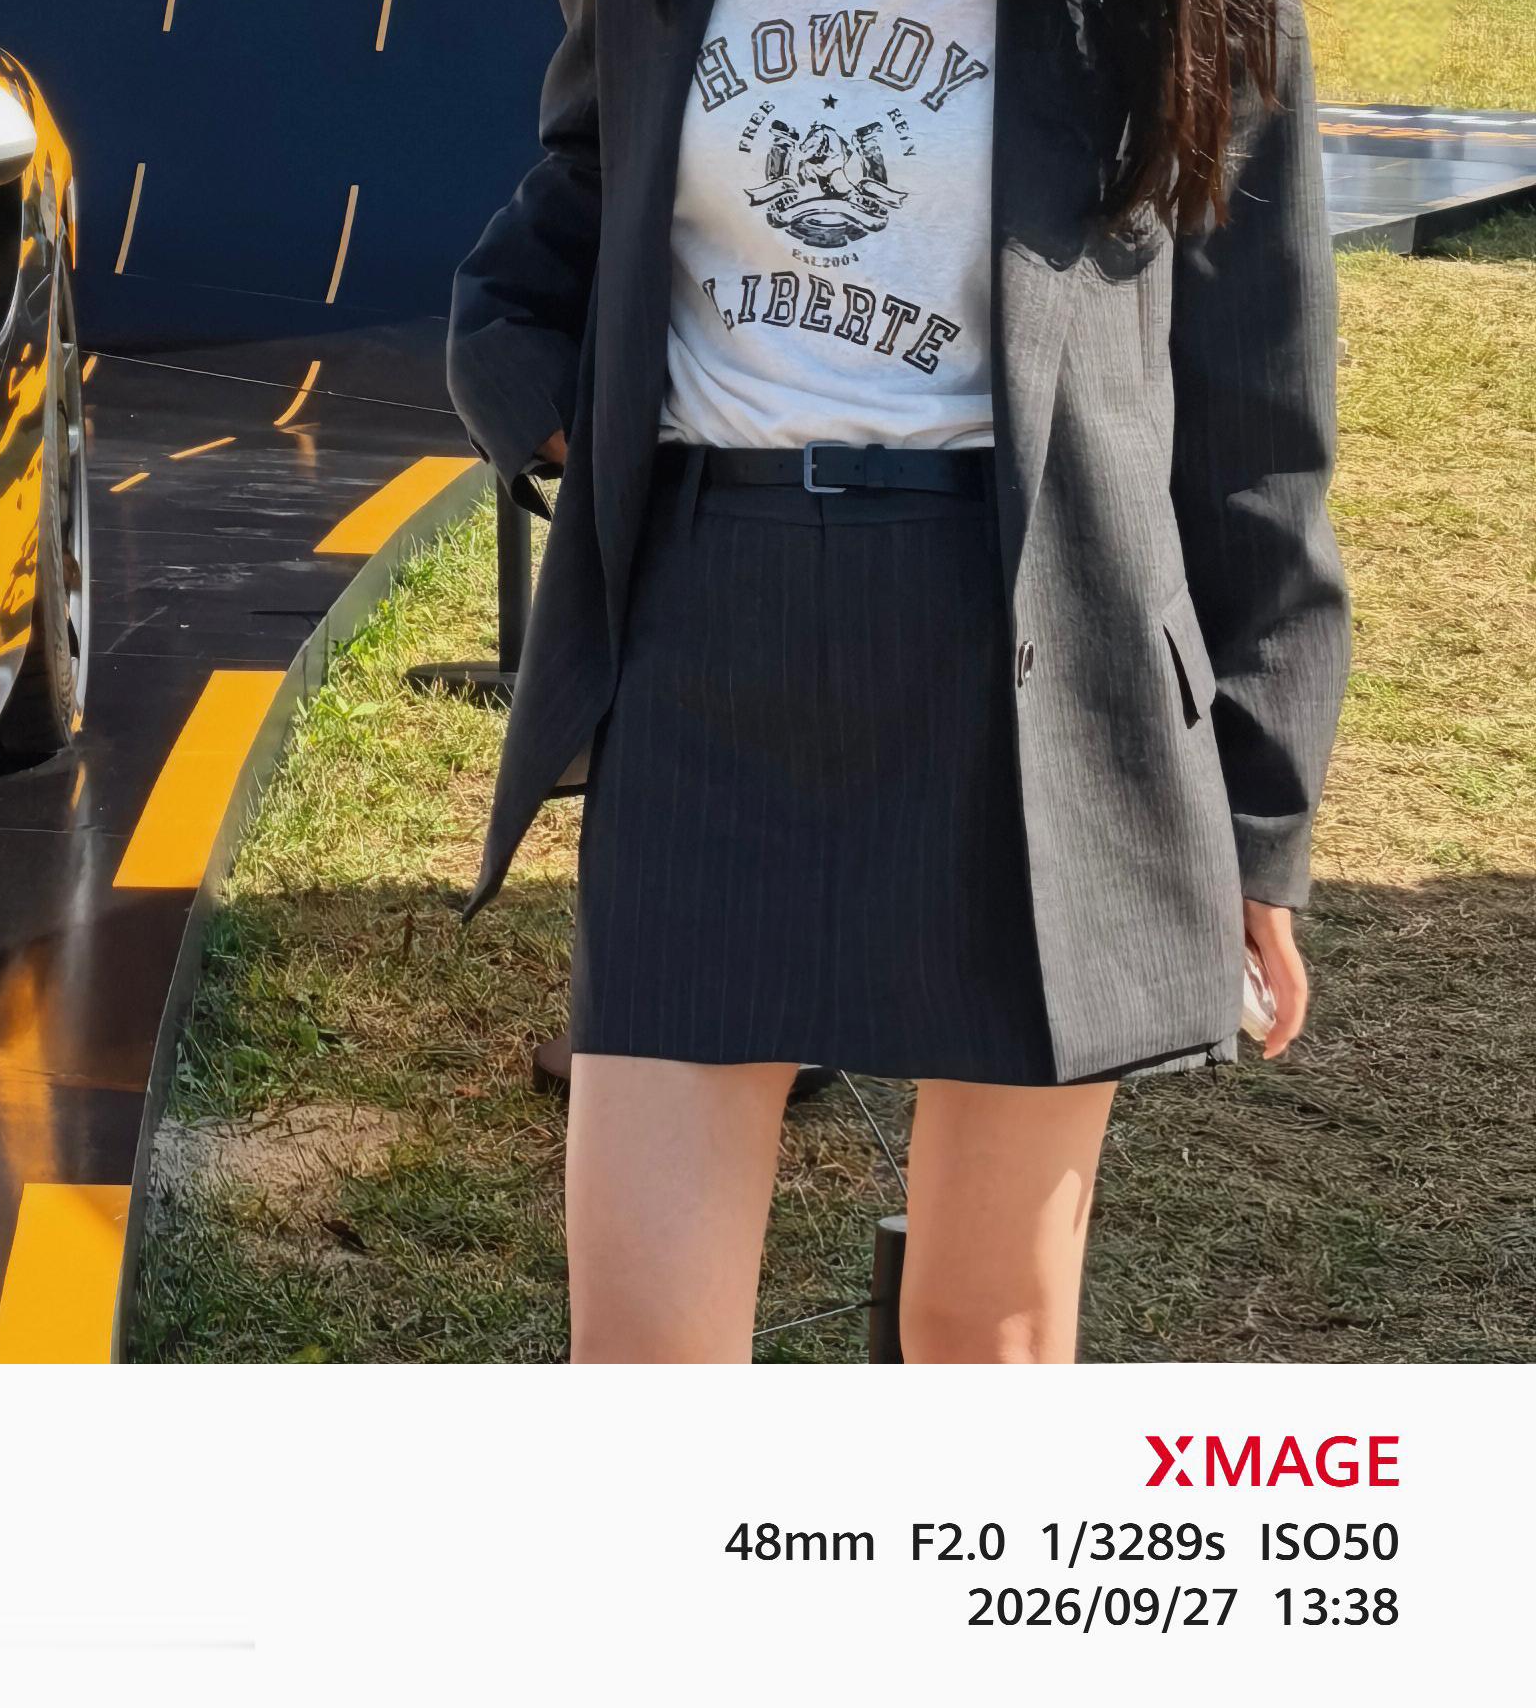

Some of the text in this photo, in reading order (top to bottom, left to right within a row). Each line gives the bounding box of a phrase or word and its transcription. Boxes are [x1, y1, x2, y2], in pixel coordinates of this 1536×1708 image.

[695, 9, 990, 113] HOWDY
[738, 100, 776, 154] FREE
[702, 269, 961, 375] LIBERTE
